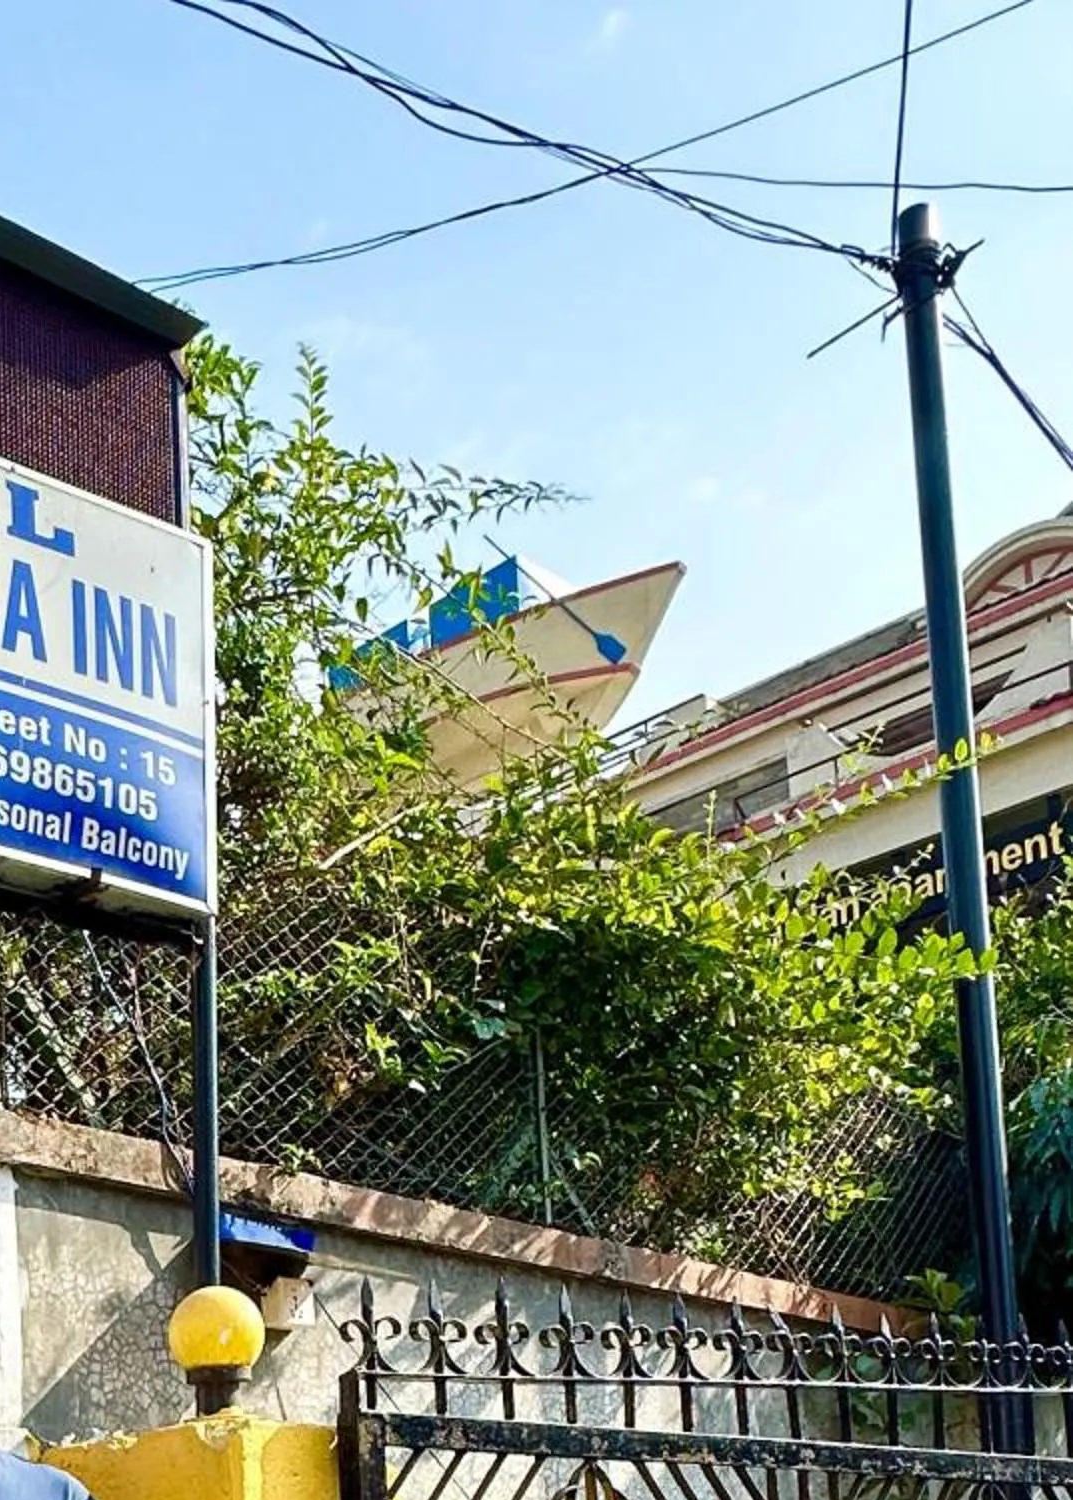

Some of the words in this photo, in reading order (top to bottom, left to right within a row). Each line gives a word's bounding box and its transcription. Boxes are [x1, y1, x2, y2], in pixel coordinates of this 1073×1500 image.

[70, 579, 178, 707] INN
[63, 721, 107, 764] No
[141, 750, 176, 788] 15
[81, 816, 191, 880] Balcony
